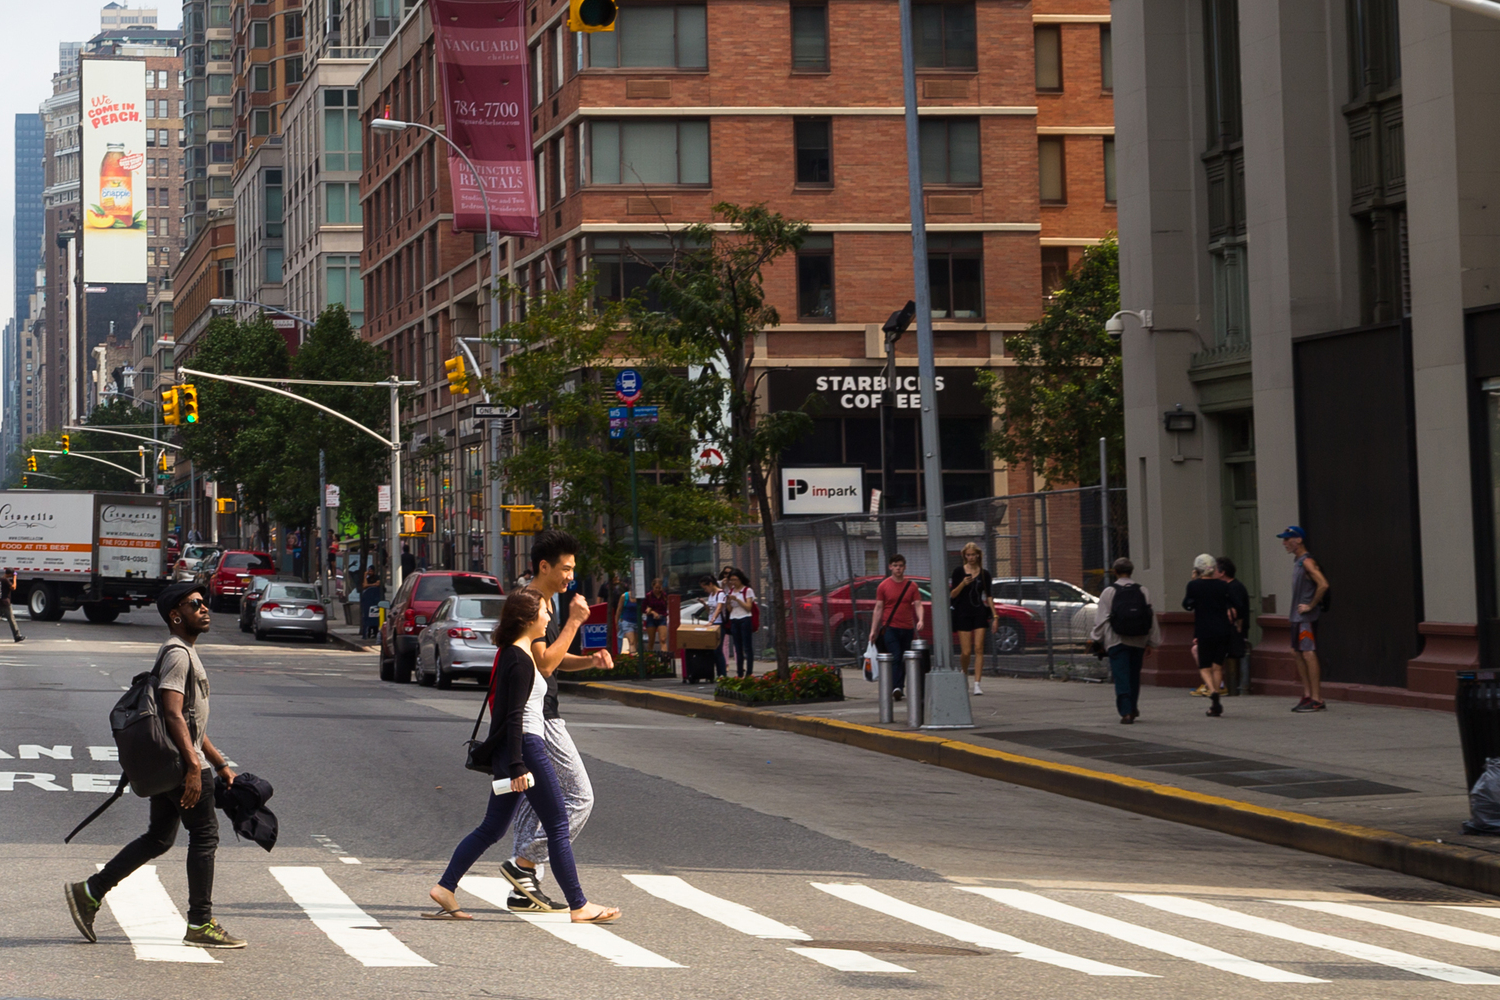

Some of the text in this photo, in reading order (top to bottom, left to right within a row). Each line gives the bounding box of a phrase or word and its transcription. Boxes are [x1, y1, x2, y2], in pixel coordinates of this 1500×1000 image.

[444, 39, 519, 52] VANGUARD
[91, 94, 112, 107] We
[88, 103, 135, 118] COME IN
[453, 100, 519, 118] 784-7700
[91, 111, 142, 129] PEACH.
[460, 163, 522, 175] DITINCTIVE
[840, 394, 921, 409] COFEE
[812, 485, 857, 498] impark
[102, 504, 157, 523] Citarella
